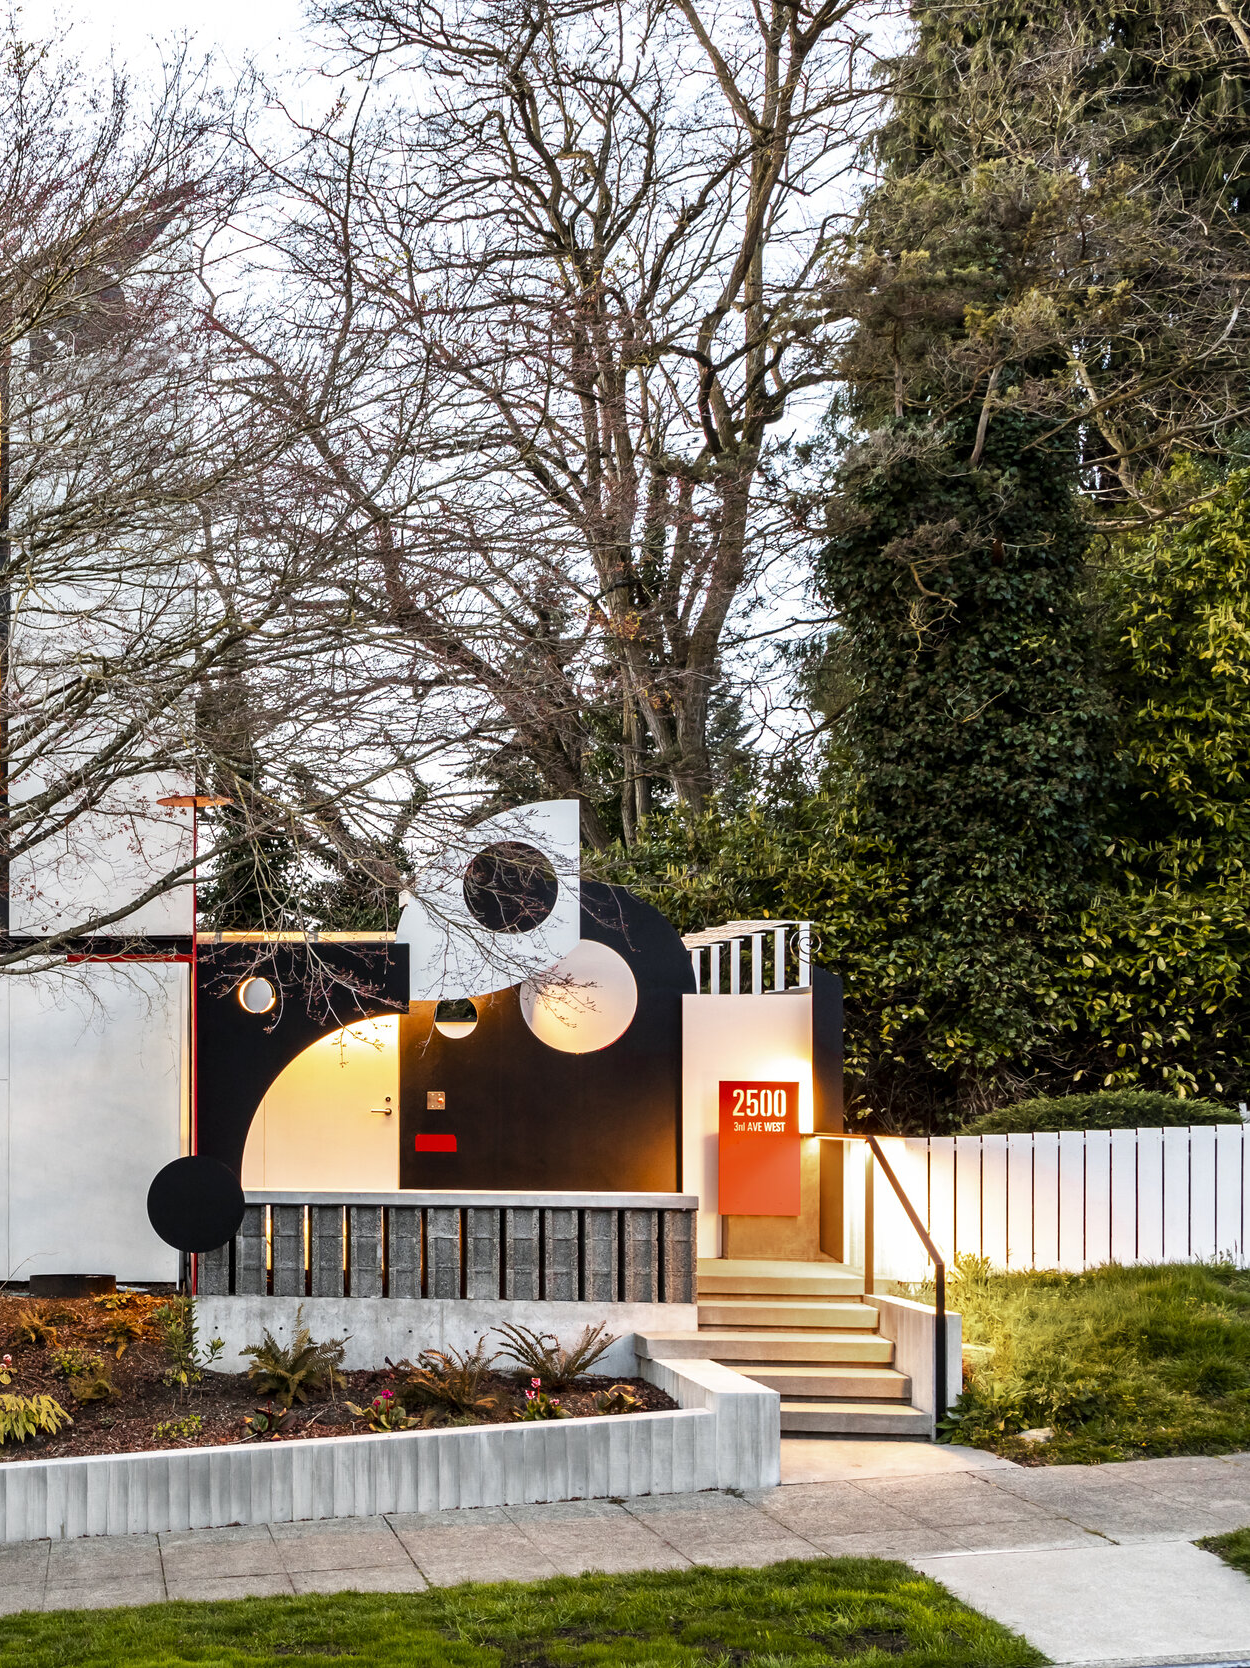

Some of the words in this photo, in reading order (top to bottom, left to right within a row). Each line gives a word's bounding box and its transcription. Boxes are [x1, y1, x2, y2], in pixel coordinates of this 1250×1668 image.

[732, 1089, 787, 1117] 2500
[733, 1121, 745, 1132] 3rd
[747, 1122, 762, 1132] AVE
[764, 1121, 786, 1133] WEST
